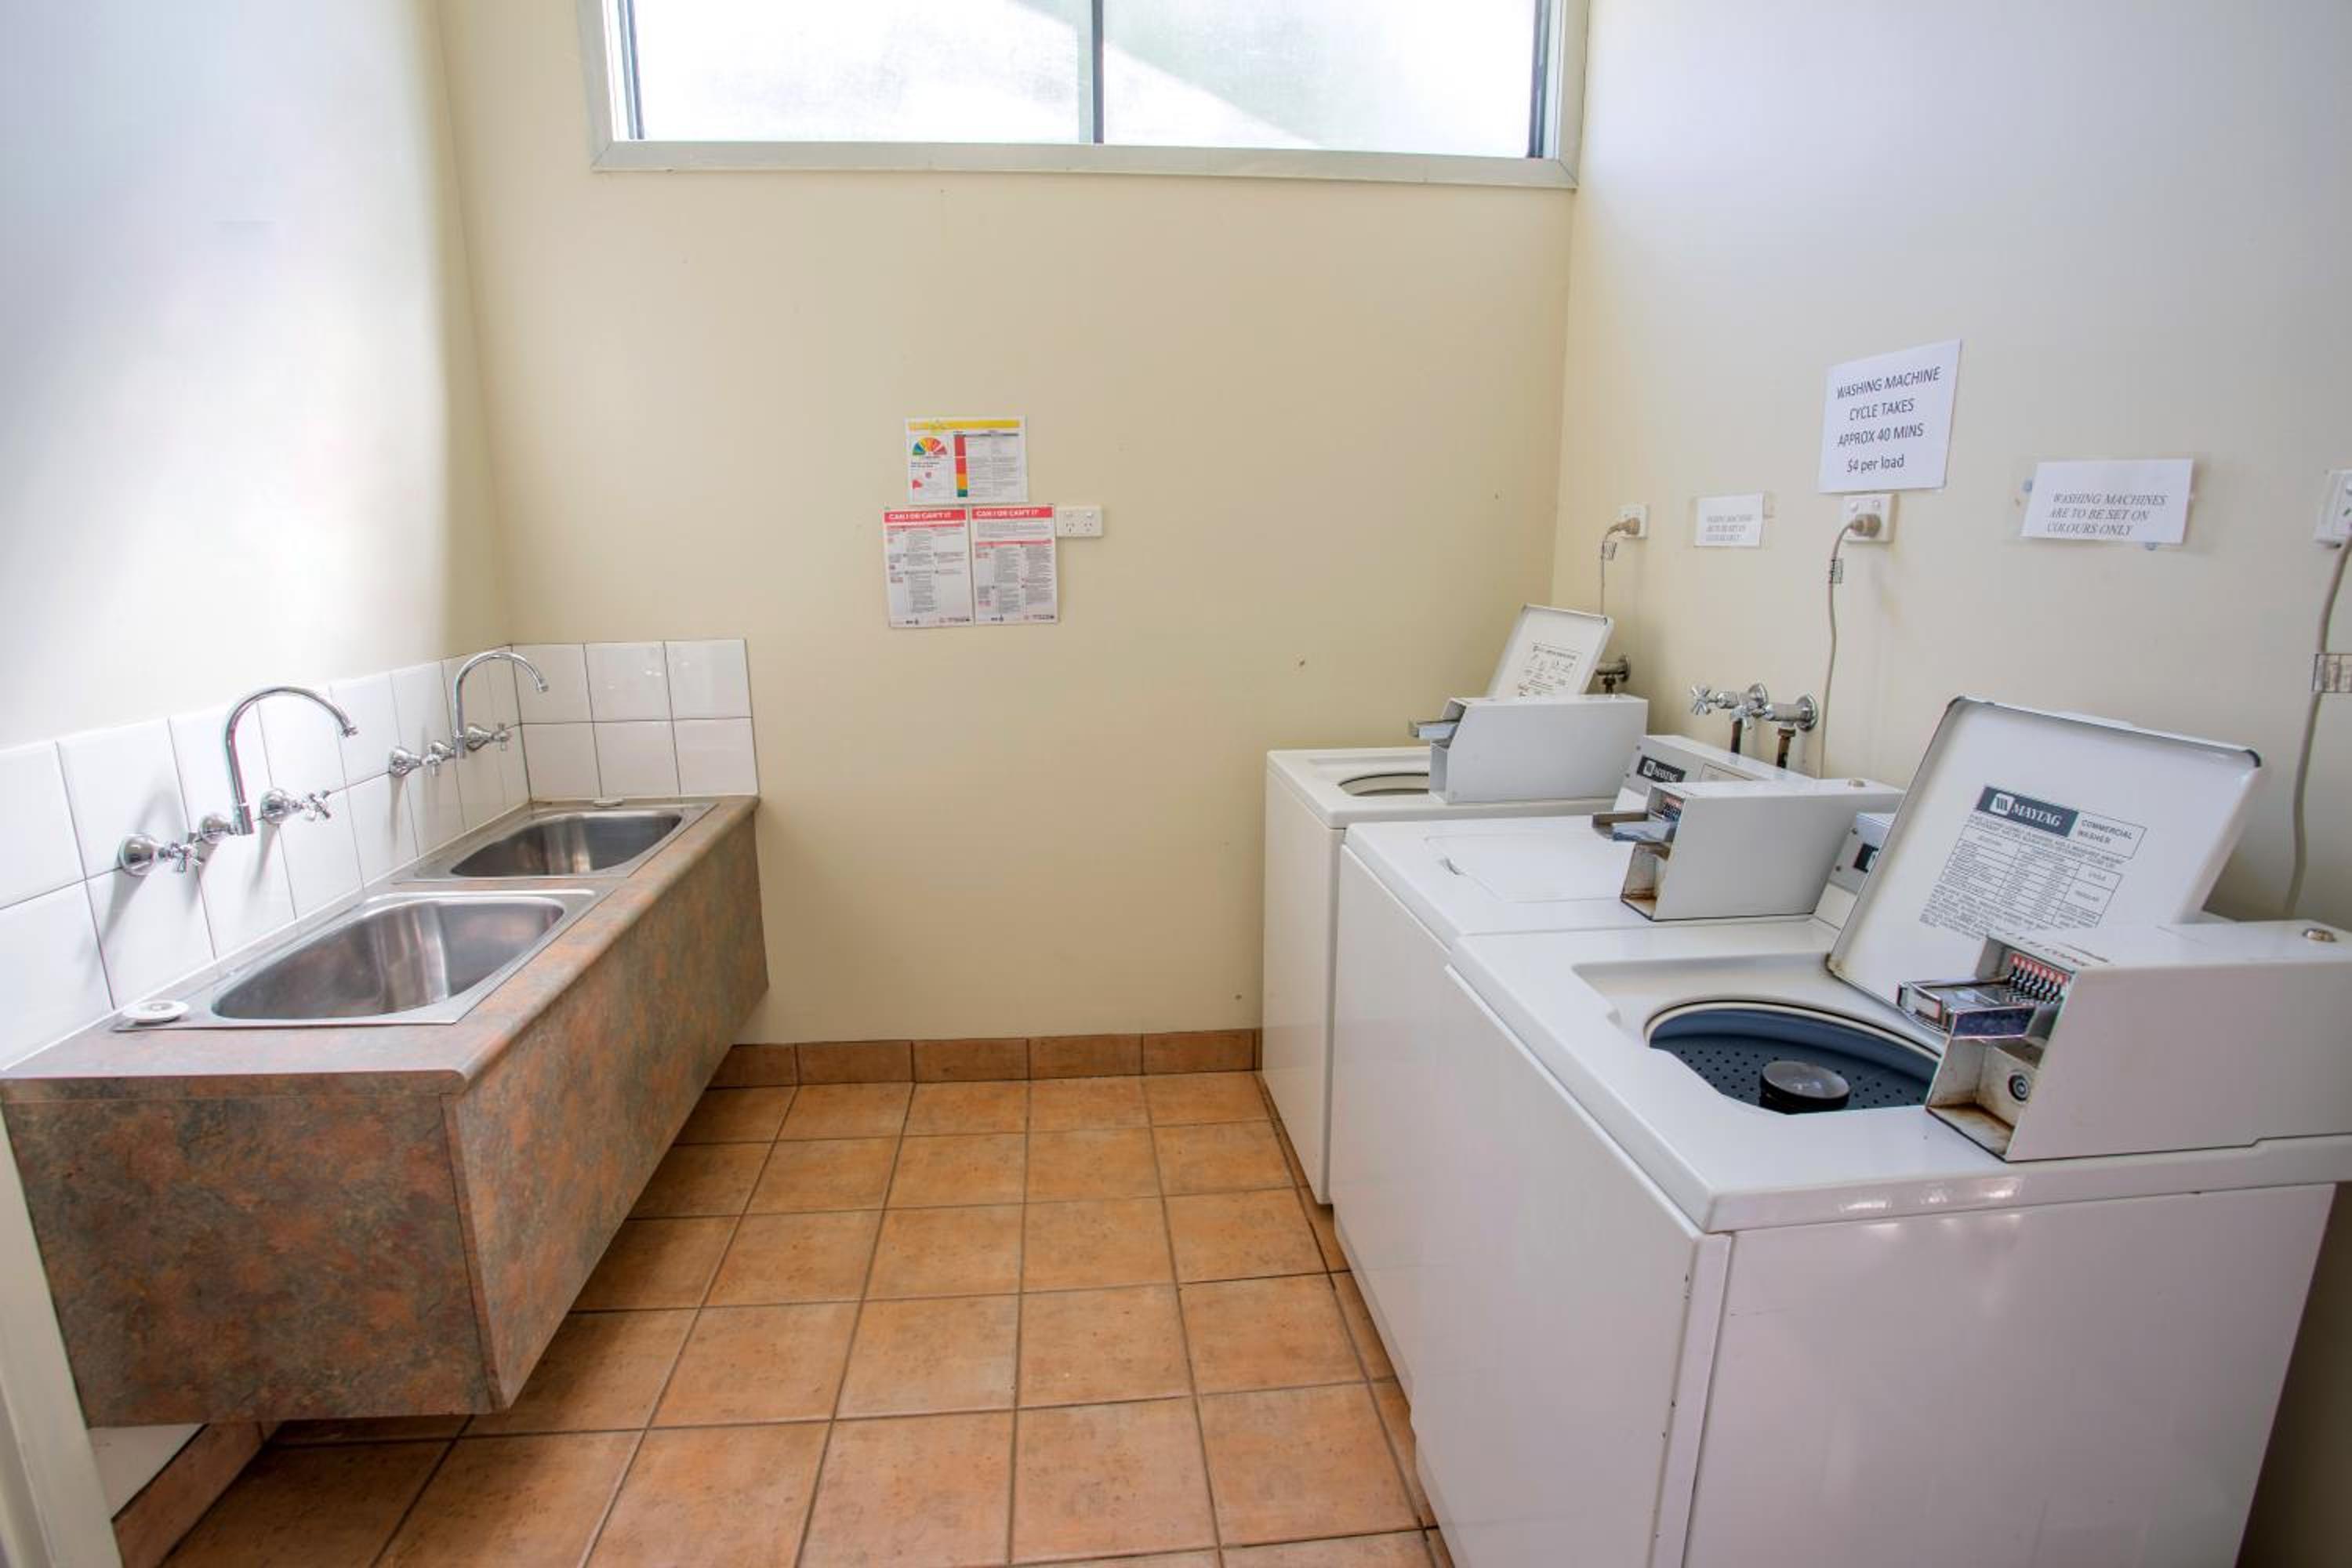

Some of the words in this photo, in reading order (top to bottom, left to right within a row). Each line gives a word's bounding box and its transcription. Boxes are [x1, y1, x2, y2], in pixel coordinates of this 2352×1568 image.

[1837, 377, 1882, 399] WASHING
[1884, 366, 1941, 390] MACHINE
[1849, 404, 1878, 421] CYCLE
[1882, 398, 1915, 415] TAKES
[1837, 430, 1875, 448] APPROX
[1877, 427, 1891, 441] 40
[1893, 423, 1924, 439] MINS
[1860, 460, 1878, 474] per
[1881, 454, 1904, 469] load
[2053, 493, 2102, 505] WASHING
[2104, 495, 2168, 506] MACHINES
[2050, 508, 2068, 518] ARE
[2071, 508, 2086, 519] TO
[2088, 510, 2104, 520] BE
[2106, 510, 2129, 521] SET
[2131, 510, 2150, 521] ON
[2046, 522, 2099, 534] COLOURS
[2100, 524, 2134, 536] ONLY
[2012, 803, 2063, 827] MAYTAG
[2082, 819, 2132, 840] COMMERCIAL
